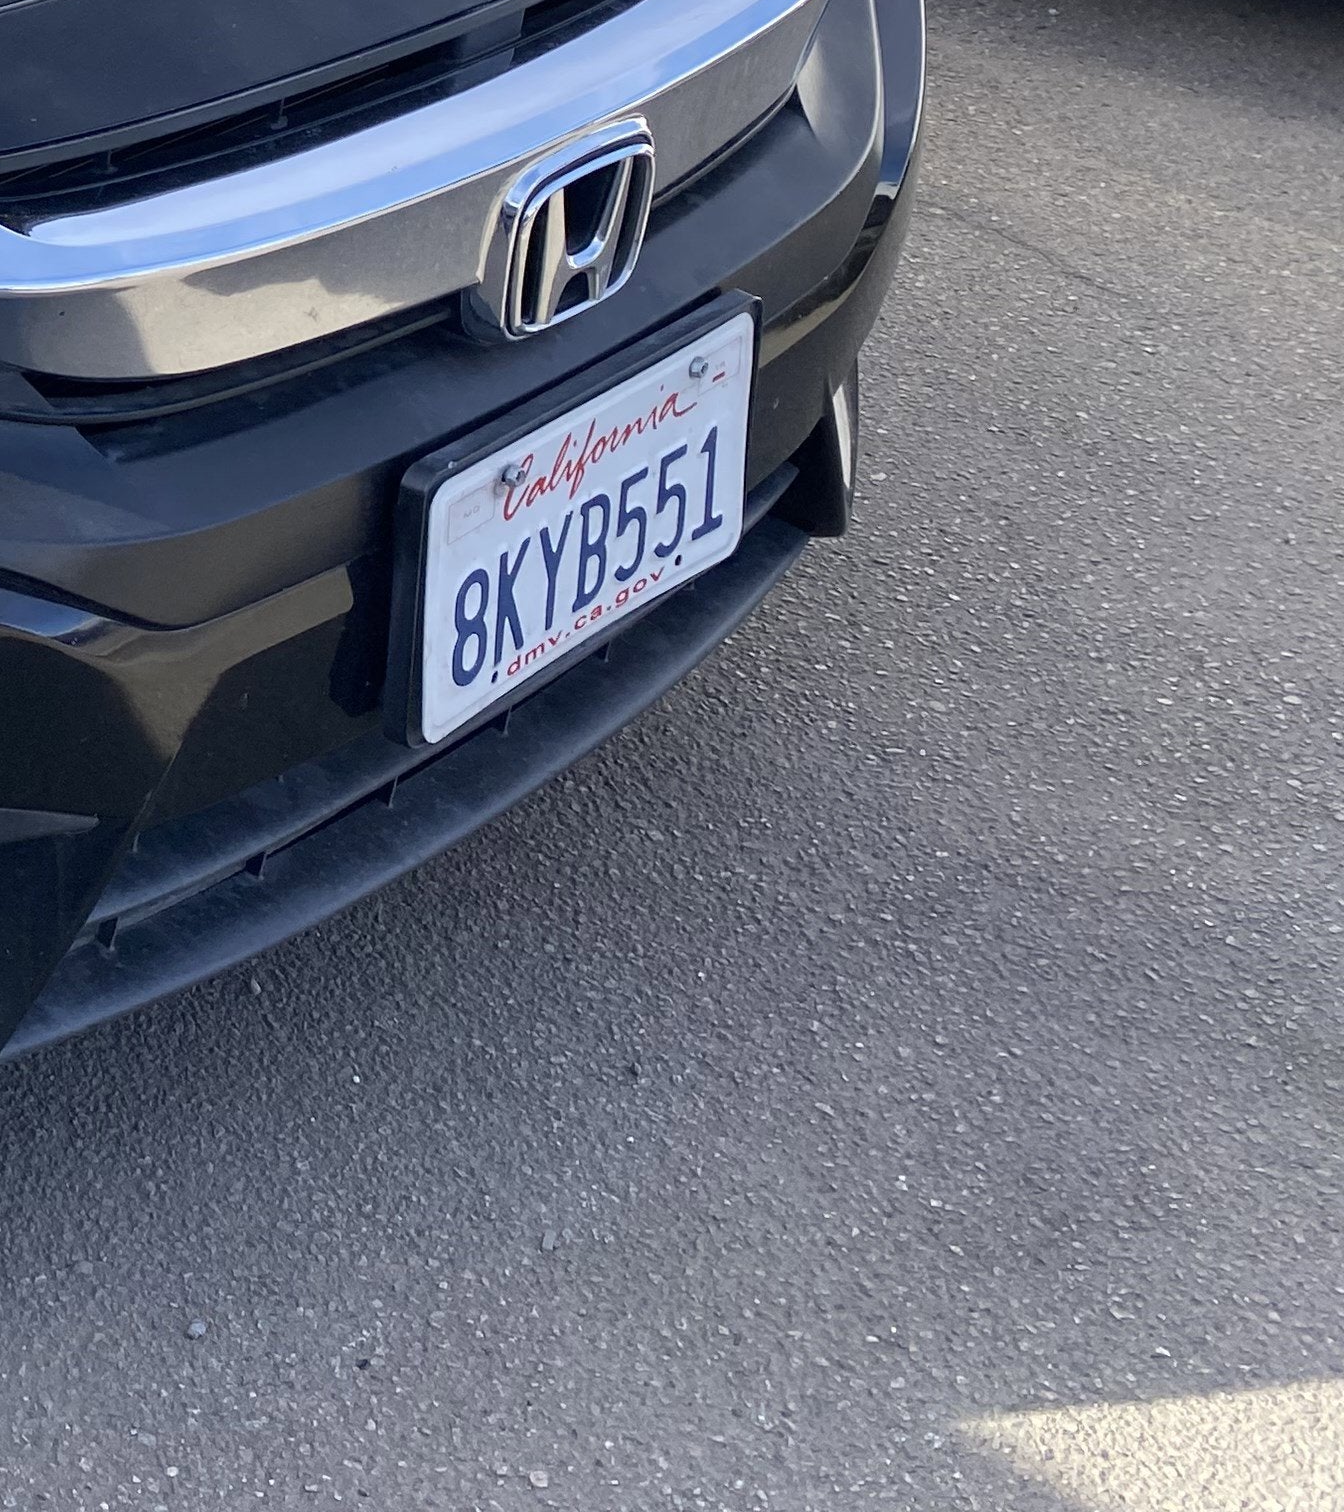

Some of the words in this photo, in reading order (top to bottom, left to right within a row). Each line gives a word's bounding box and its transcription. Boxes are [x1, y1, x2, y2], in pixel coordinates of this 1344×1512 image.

[503, 385, 698, 521] California
[450, 425, 724, 687] 8KYB551
[506, 566, 665, 677] dmv.ca.gov
